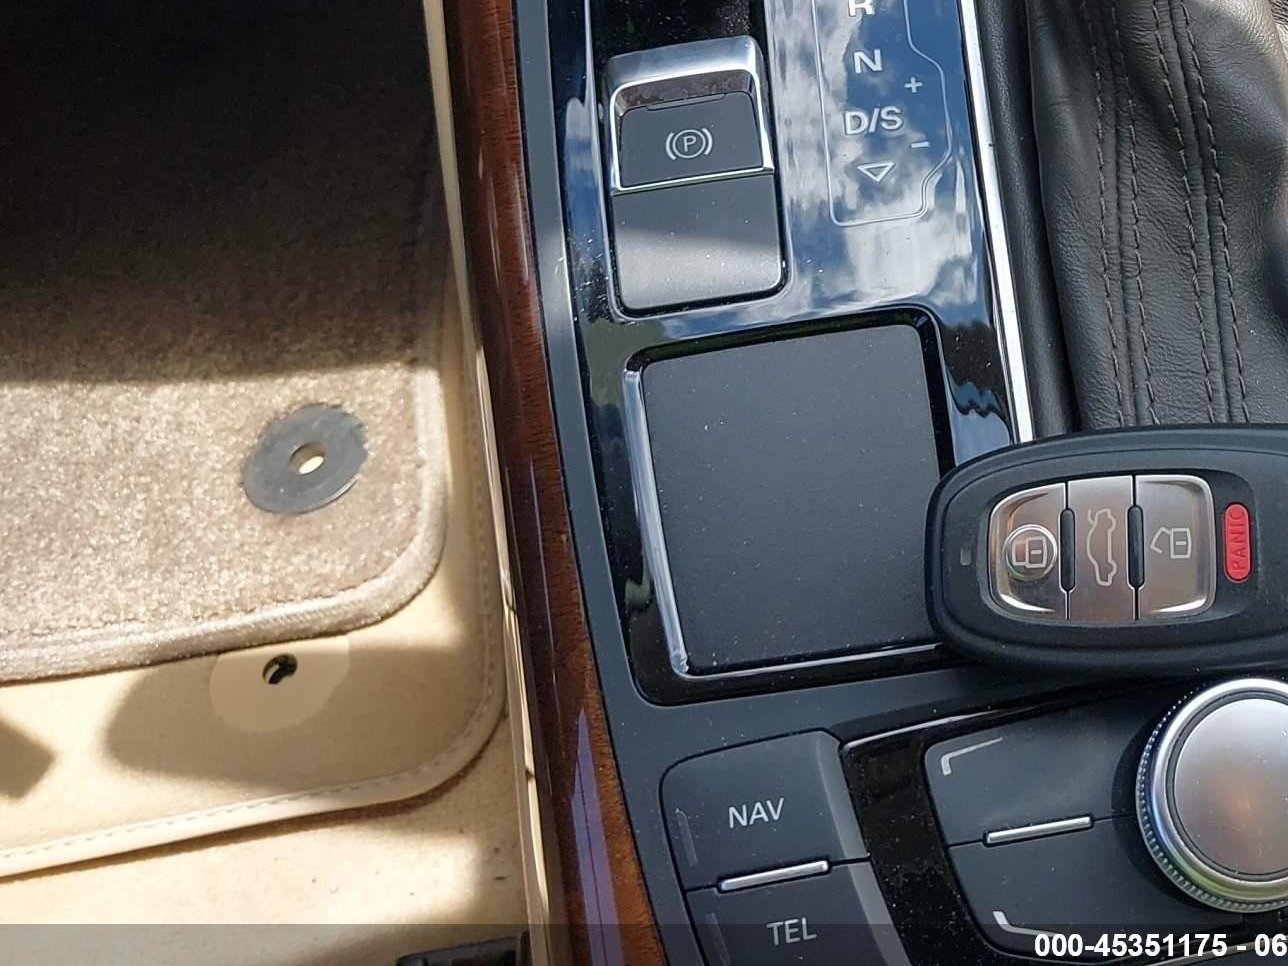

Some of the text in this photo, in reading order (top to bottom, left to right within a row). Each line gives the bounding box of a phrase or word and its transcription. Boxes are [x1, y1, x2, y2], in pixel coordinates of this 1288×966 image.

[854, 49, 883, 73] N
[844, 105, 904, 135] D/S
[1229, 509, 1247, 571] PANIC
[728, 797, 785, 829] NAV
[766, 917, 817, 946] TEL
